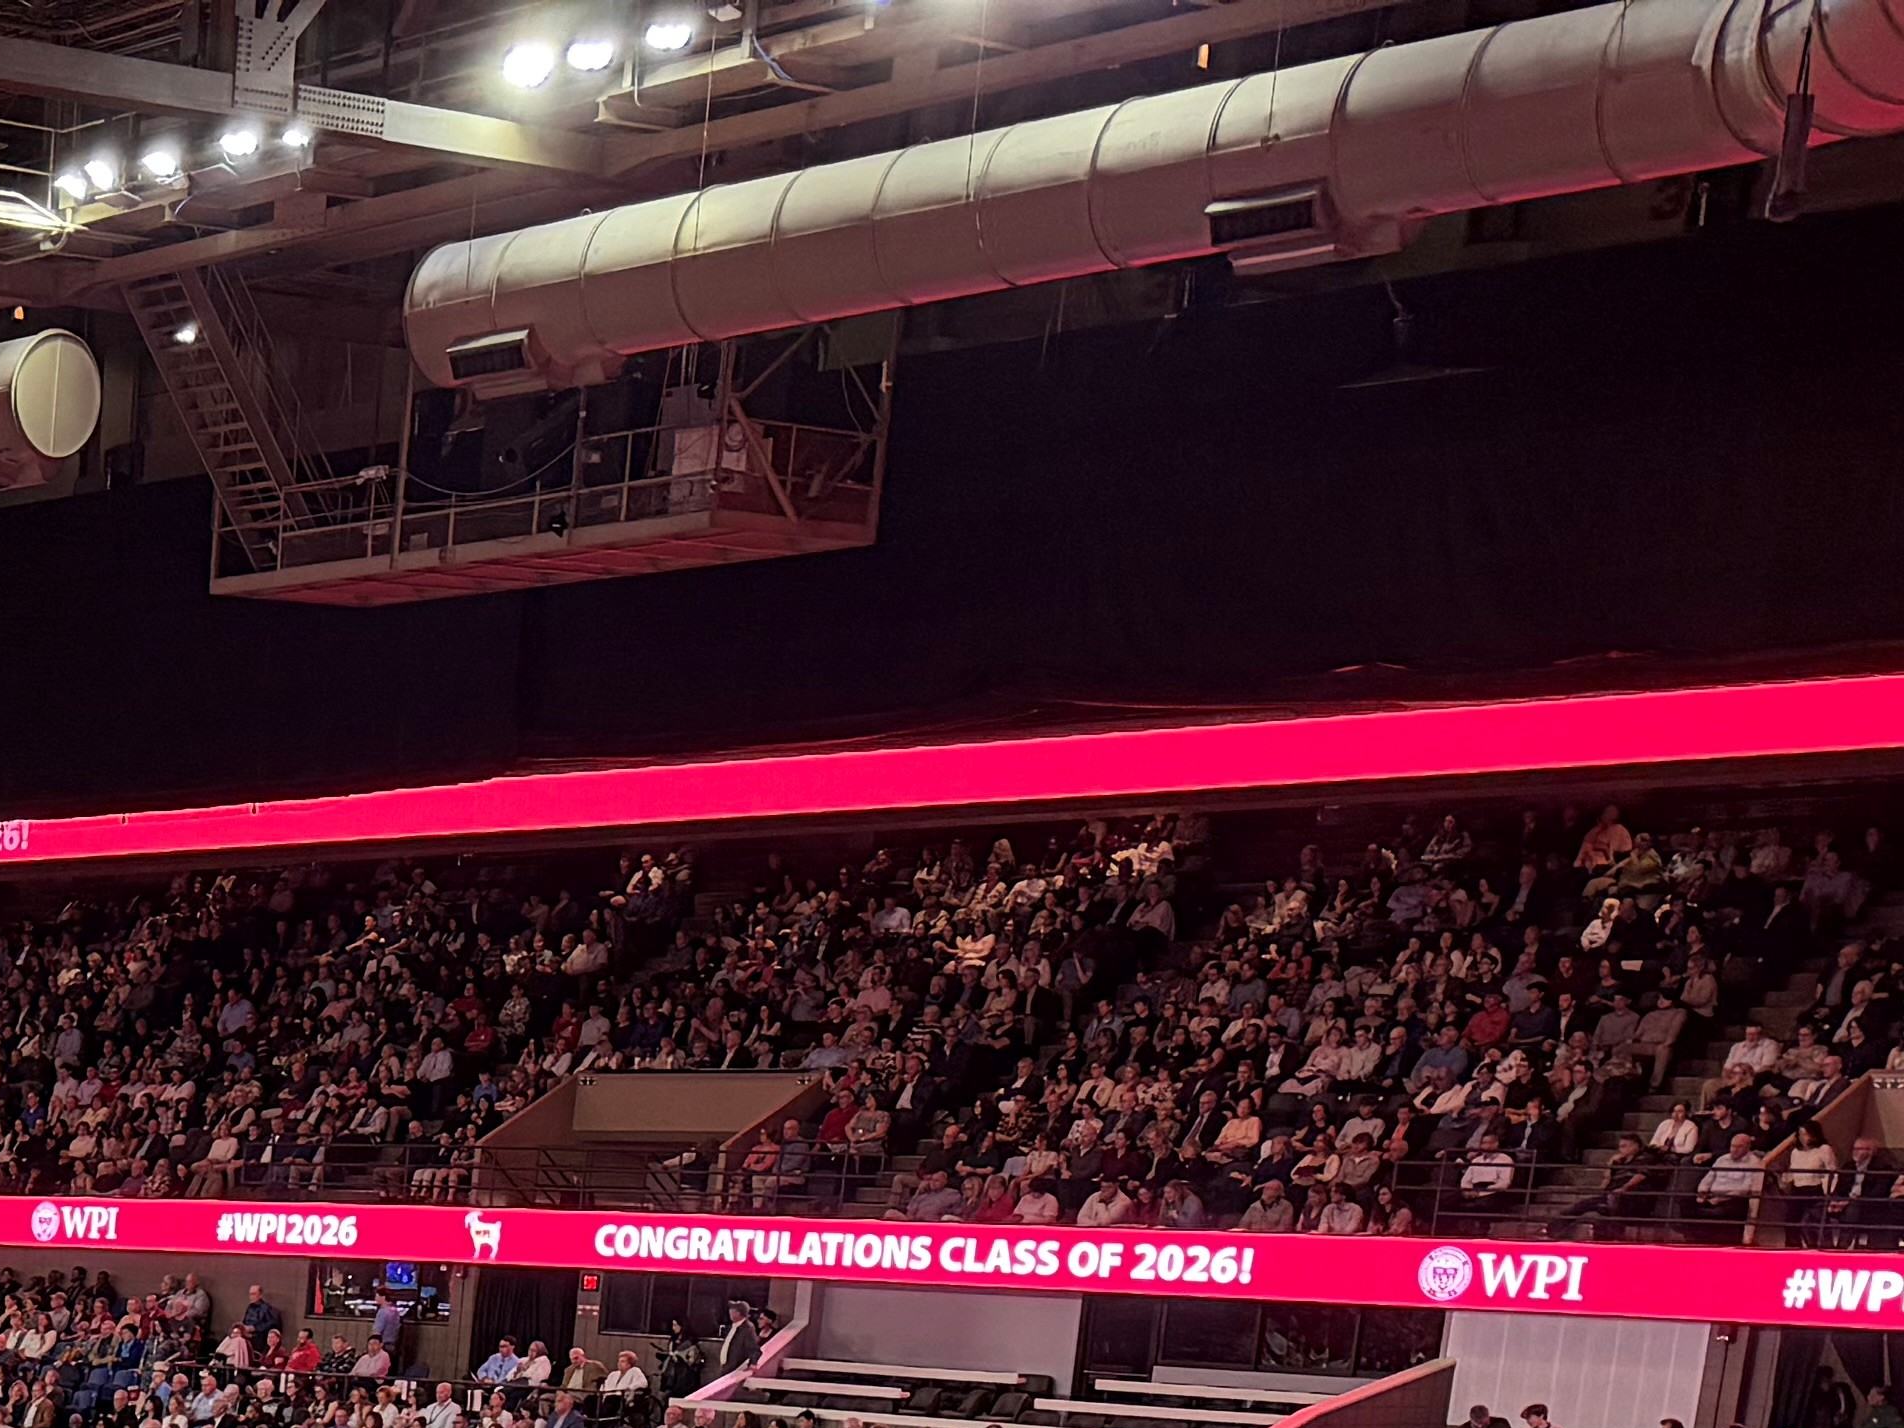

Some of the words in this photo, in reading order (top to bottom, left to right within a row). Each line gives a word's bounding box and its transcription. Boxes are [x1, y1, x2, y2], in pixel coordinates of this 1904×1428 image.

[59, 1206, 119, 1241] WPI
[215, 1212, 359, 1247] #WPI2026
[594, 1223, 932, 1271] CONGRATULATIONS
[939, 1236, 1061, 1277] CLASS
[1067, 1241, 1123, 1280] OF
[1129, 1243, 1255, 1285] 2026!
[1477, 1252, 1590, 1302] WPI
